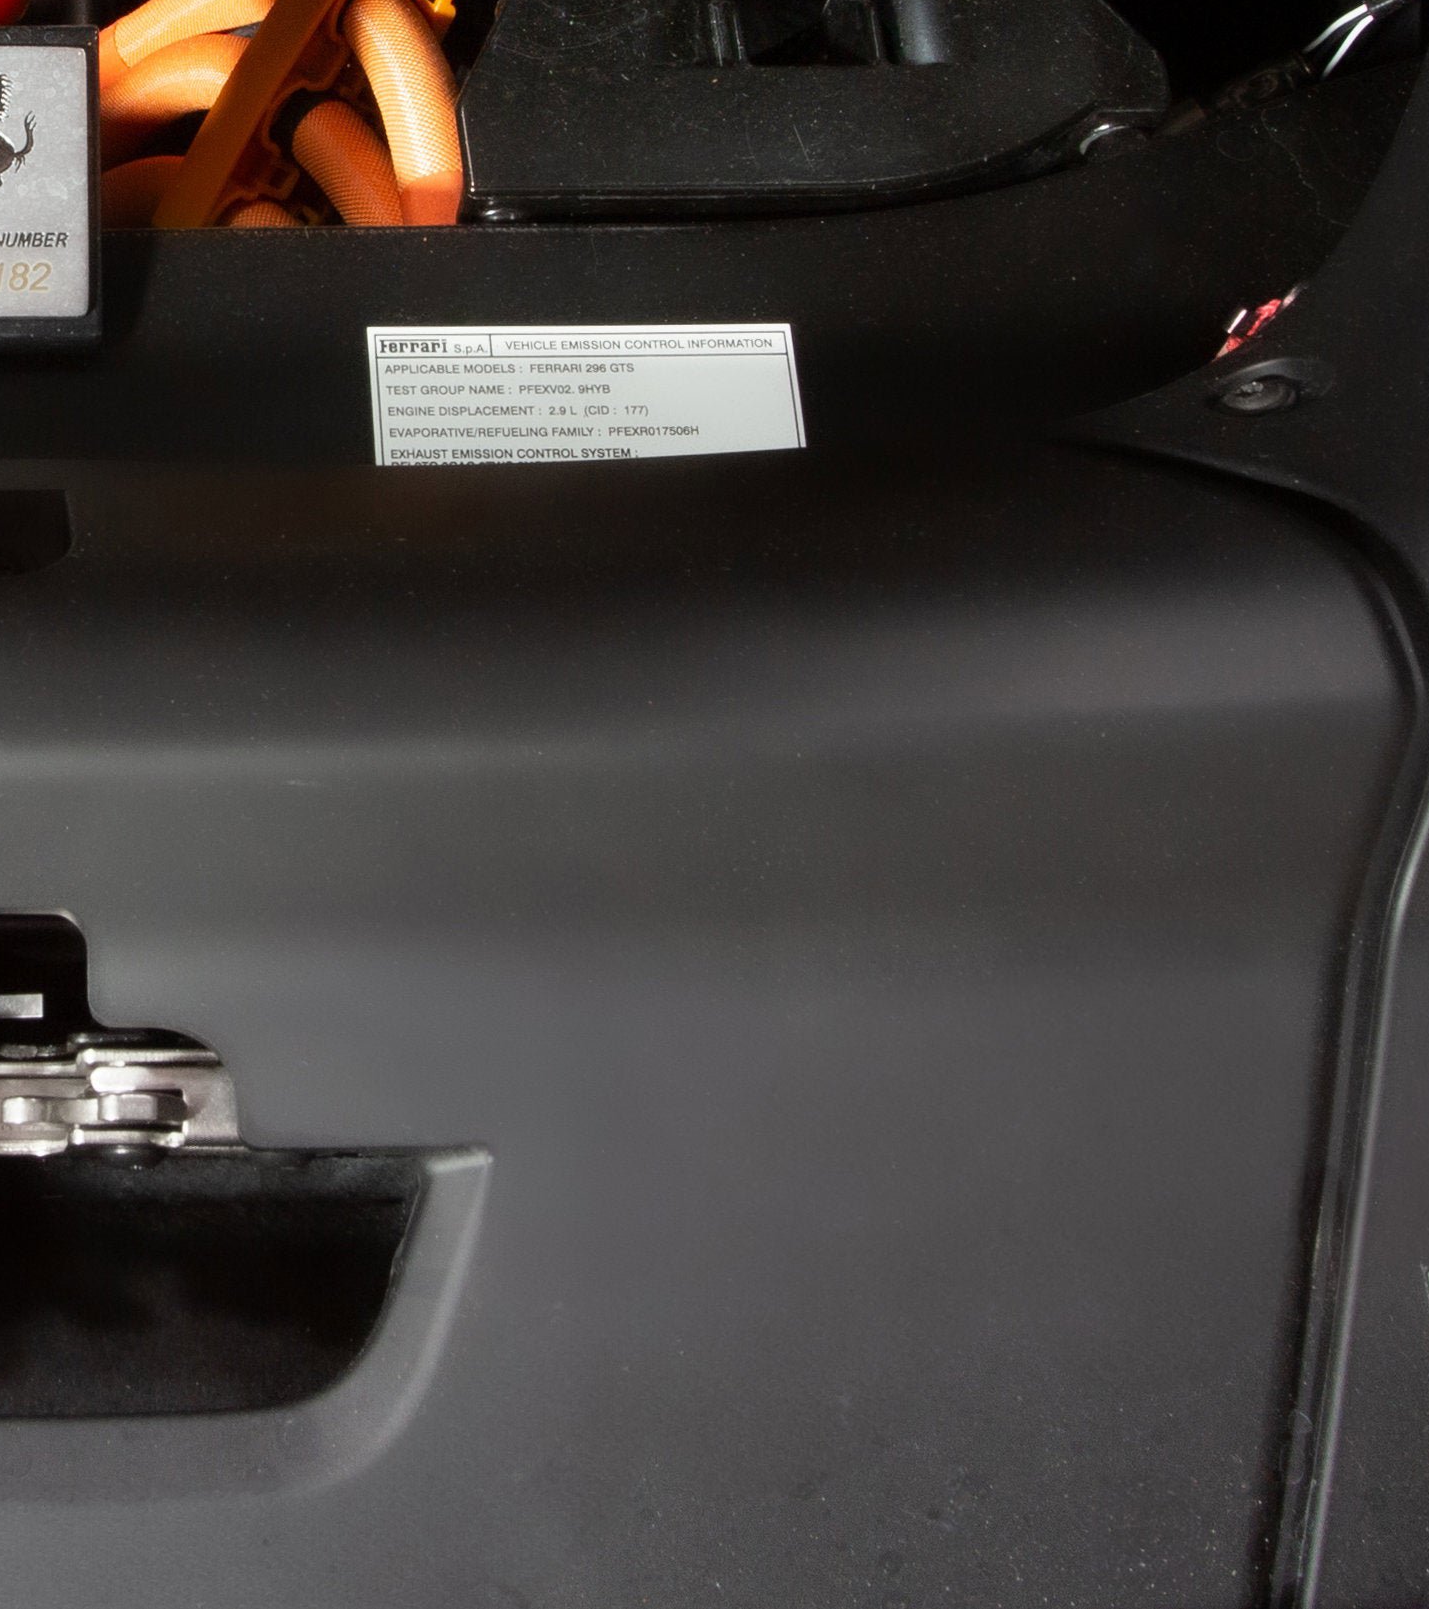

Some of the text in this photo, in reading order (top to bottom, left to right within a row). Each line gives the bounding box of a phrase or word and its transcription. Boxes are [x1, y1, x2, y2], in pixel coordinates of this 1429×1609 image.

[379, 339, 448, 354] Ferrari
[506, 339, 772, 350] VEHICLE EMISSION CONTROL INFORMATION
[385, 365, 460, 374] APPLICABLE
[464, 364, 515, 373] MODELS
[530, 364, 582, 373] FERRARI
[586, 364, 606, 373] 296
[610, 363, 634, 373] GTS
[386, 386, 416, 395] TEST
[420, 385, 465, 395] GROUP
[469, 385, 504, 394] NAME
[388, 407, 435, 416] ENGINE
[439, 406, 534, 416] DISPLACEMENT
[549, 406, 566, 415] 2.9
[570, 406, 577, 415] L
[390, 427, 548, 437] EVAPORATIVE/REFUELING
[552, 427, 593, 436] FAMILY
[391, 449, 448, 459] EXHAUST
[452, 449, 513, 459] EMISSION
[517, 448, 577, 459] CONTROL
[581, 448, 631, 458] SYSTEM
